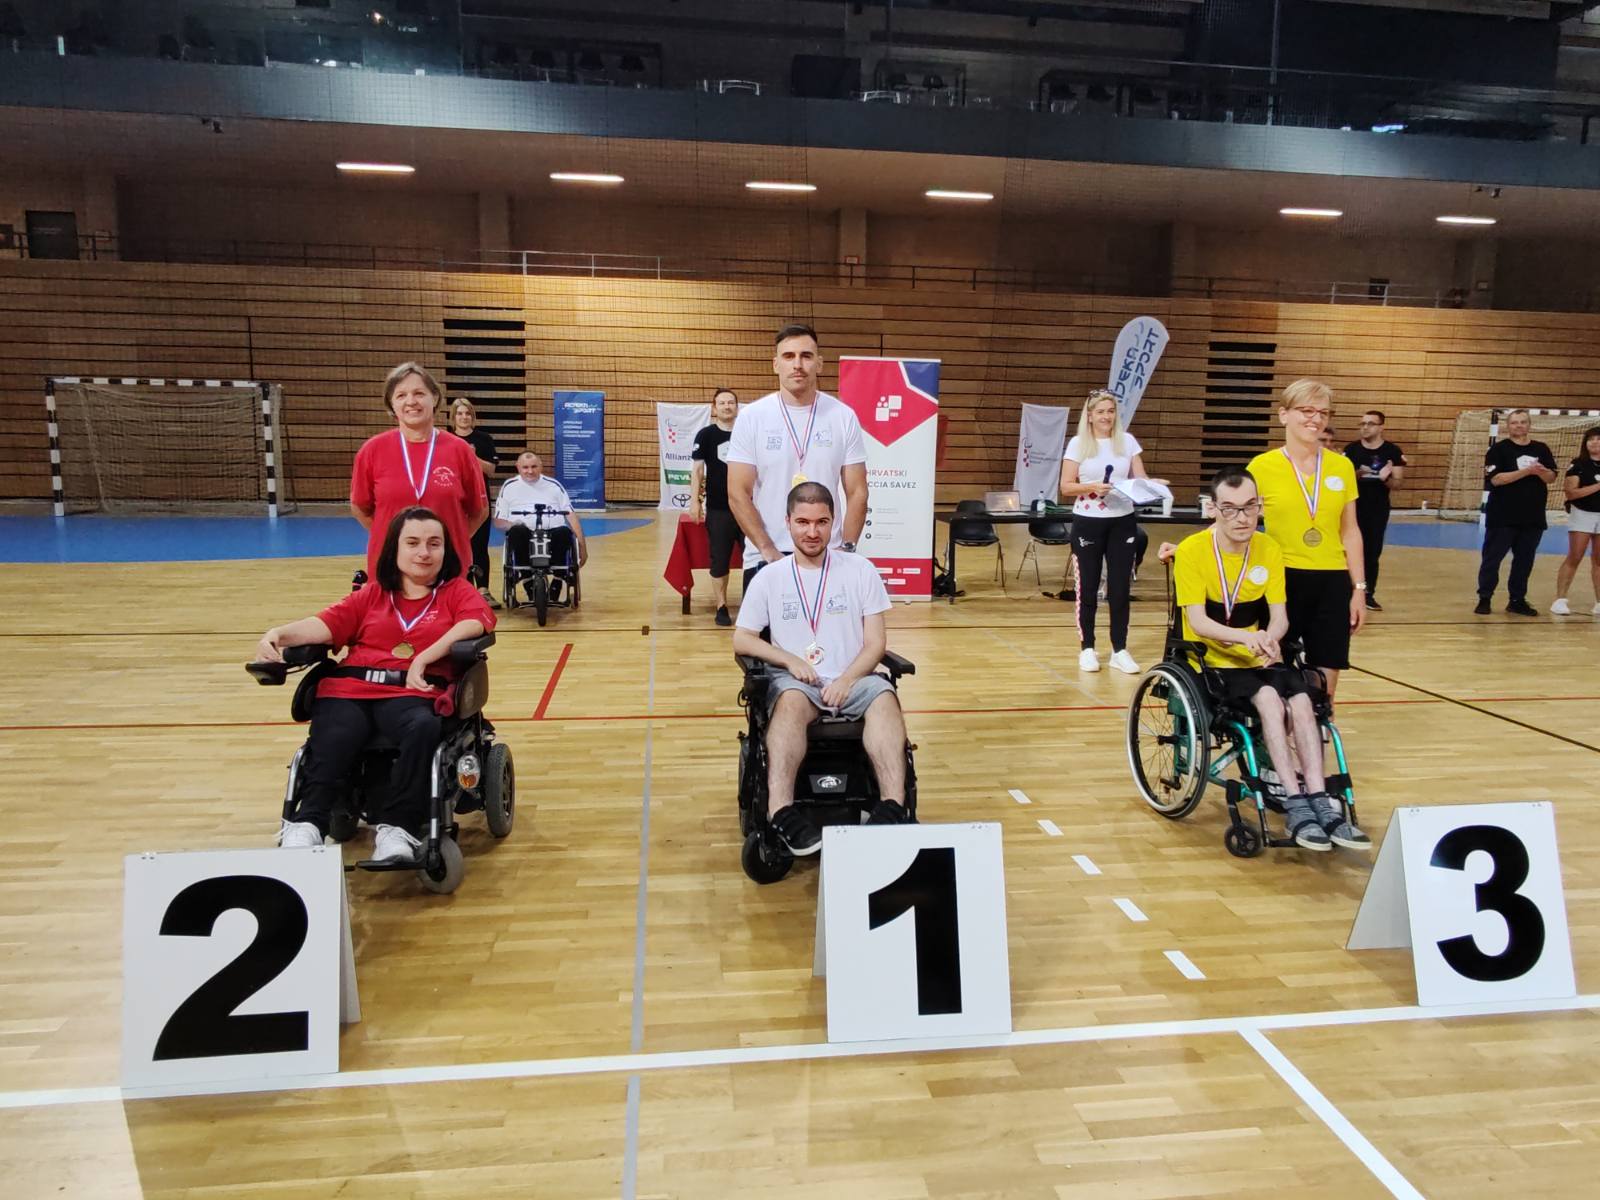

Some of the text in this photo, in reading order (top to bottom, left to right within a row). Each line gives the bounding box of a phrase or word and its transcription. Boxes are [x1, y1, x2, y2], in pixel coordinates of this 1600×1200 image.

[1134, 327, 1160, 390] SPORT
[890, 481, 917, 489] SAVEZ
[152, 874, 309, 1062] 2
[868, 847, 963, 1016] 1
[1430, 824, 1545, 982] 3
